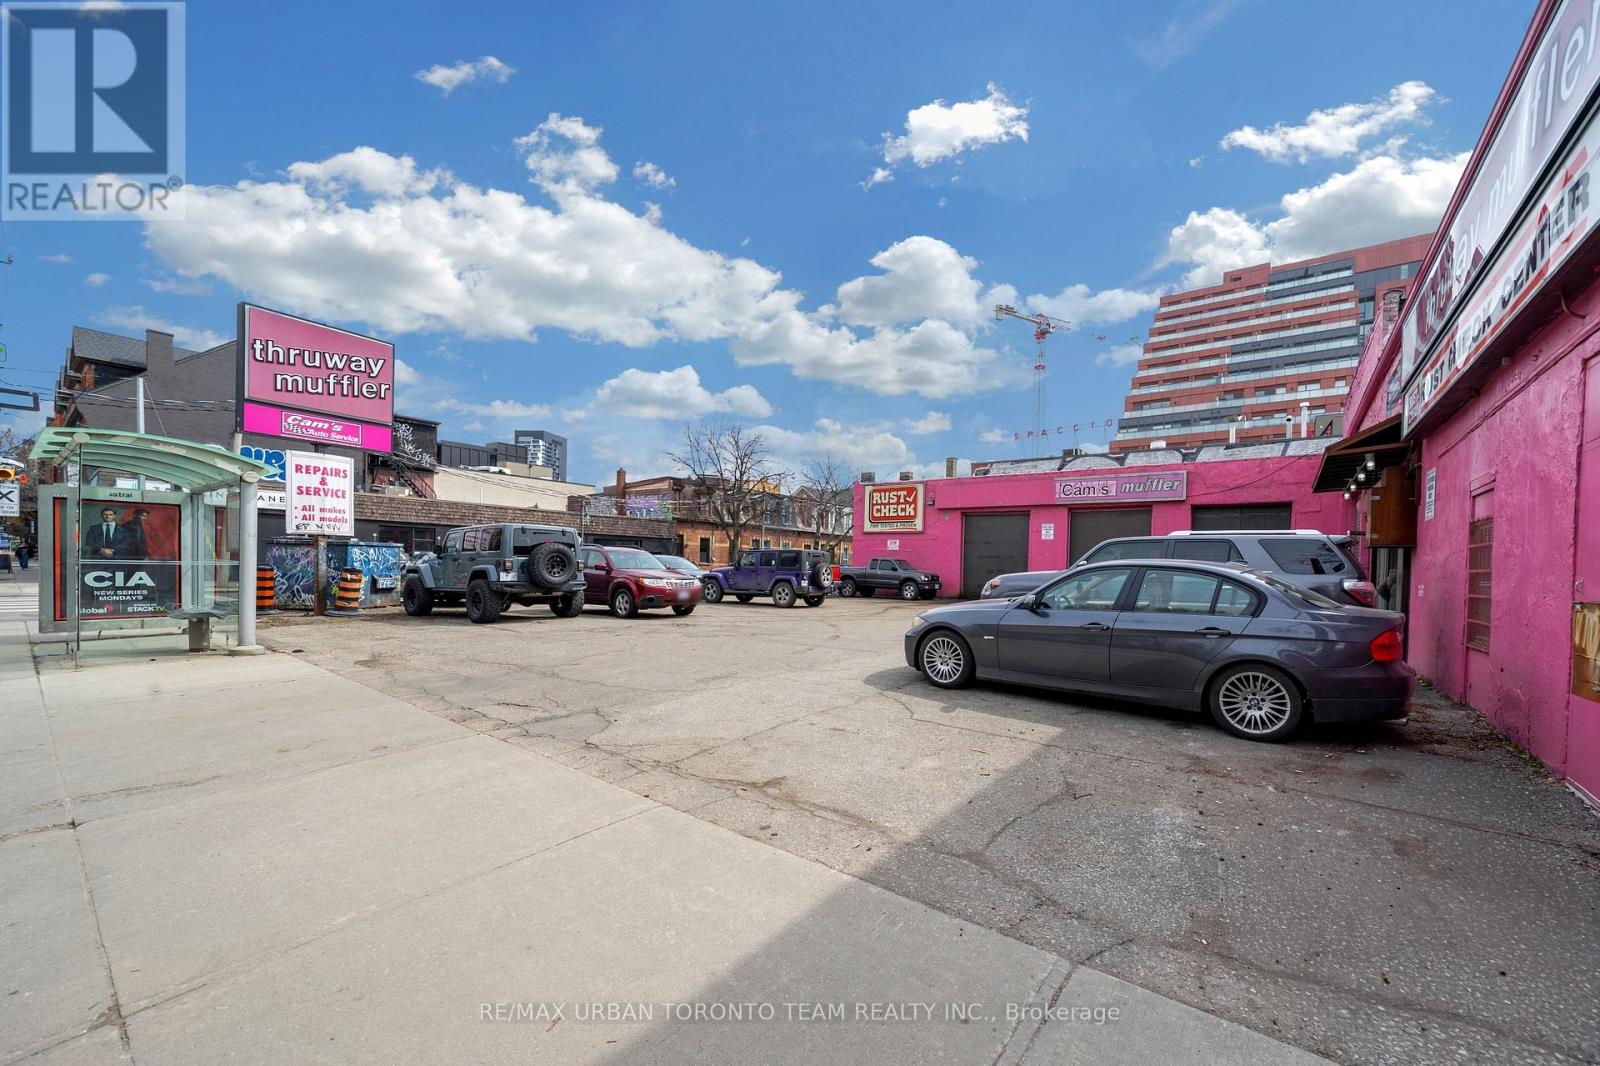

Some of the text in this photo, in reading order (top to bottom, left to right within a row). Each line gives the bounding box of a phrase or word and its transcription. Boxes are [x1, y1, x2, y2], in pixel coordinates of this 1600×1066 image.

[252, 338, 386, 378] thruway
[274, 372, 392, 400] muffler
[286, 415, 343, 432] Cam's
[1014, 418, 1113, 440] SPACCIO
[308, 428, 359, 443] Auto Service
[294, 463, 348, 479] REPAIRS
[319, 476, 328, 487] &
[1062, 478, 1181, 496] Cam's muffler
[296, 485, 347, 500] SERVICE
[872, 490, 907, 504] RUST
[301, 504, 346, 515] All makes
[873, 504, 915, 517] CHECK
[301, 514, 348, 524] All models
[84, 571, 157, 588] CIA
